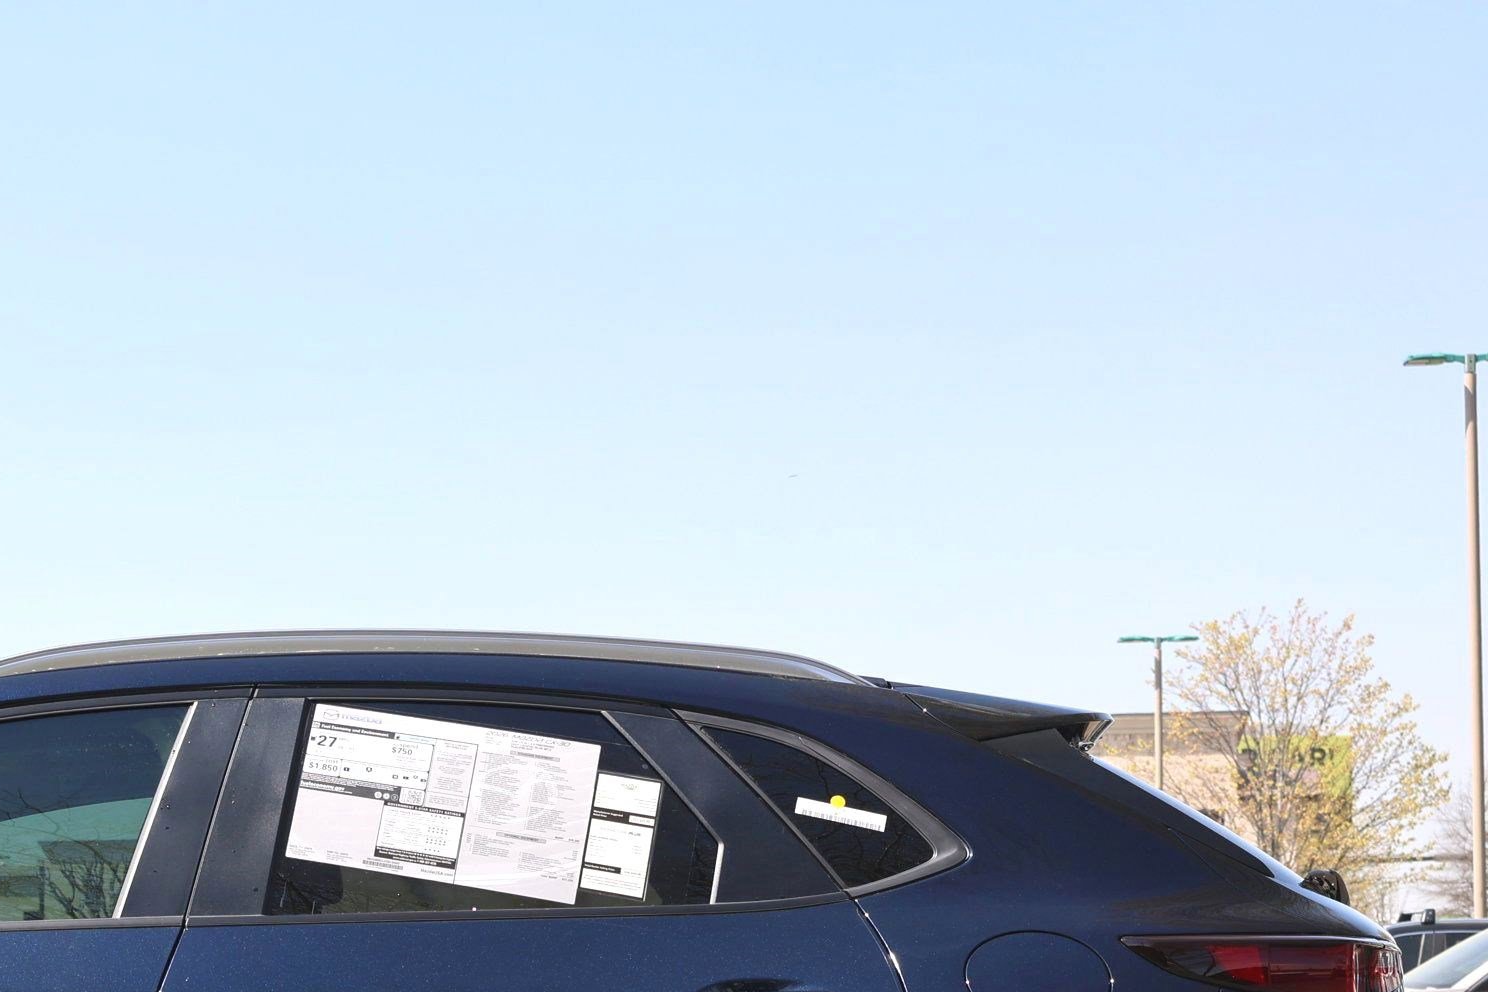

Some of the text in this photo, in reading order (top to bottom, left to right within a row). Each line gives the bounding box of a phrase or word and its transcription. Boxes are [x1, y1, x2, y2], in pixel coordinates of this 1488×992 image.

[361, 728, 389, 737] Environment
[316, 735, 338, 747] 27
[391, 747, 413, 756] $750
